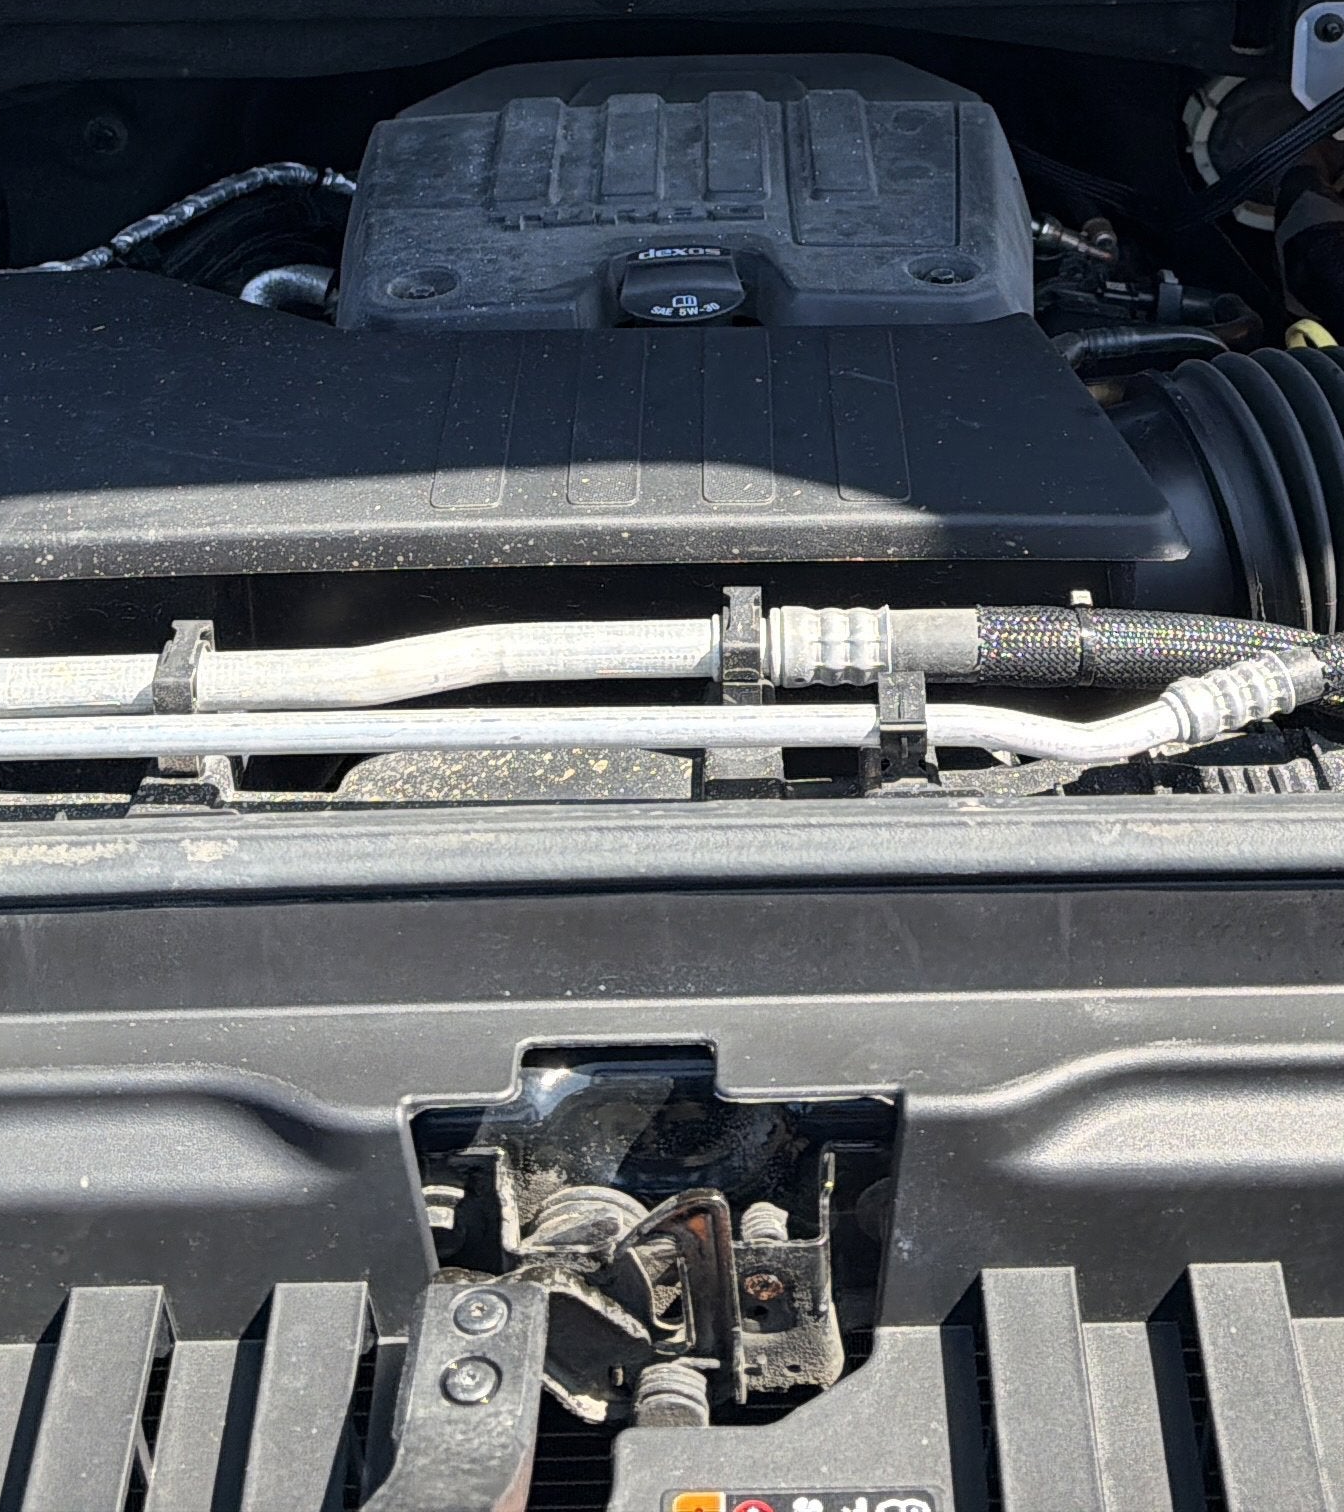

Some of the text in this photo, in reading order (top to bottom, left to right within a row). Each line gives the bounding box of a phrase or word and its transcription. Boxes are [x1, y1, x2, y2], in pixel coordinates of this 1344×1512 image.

[638, 248, 721, 259] dexos
[650, 302, 720, 316] SAE 5W-30
